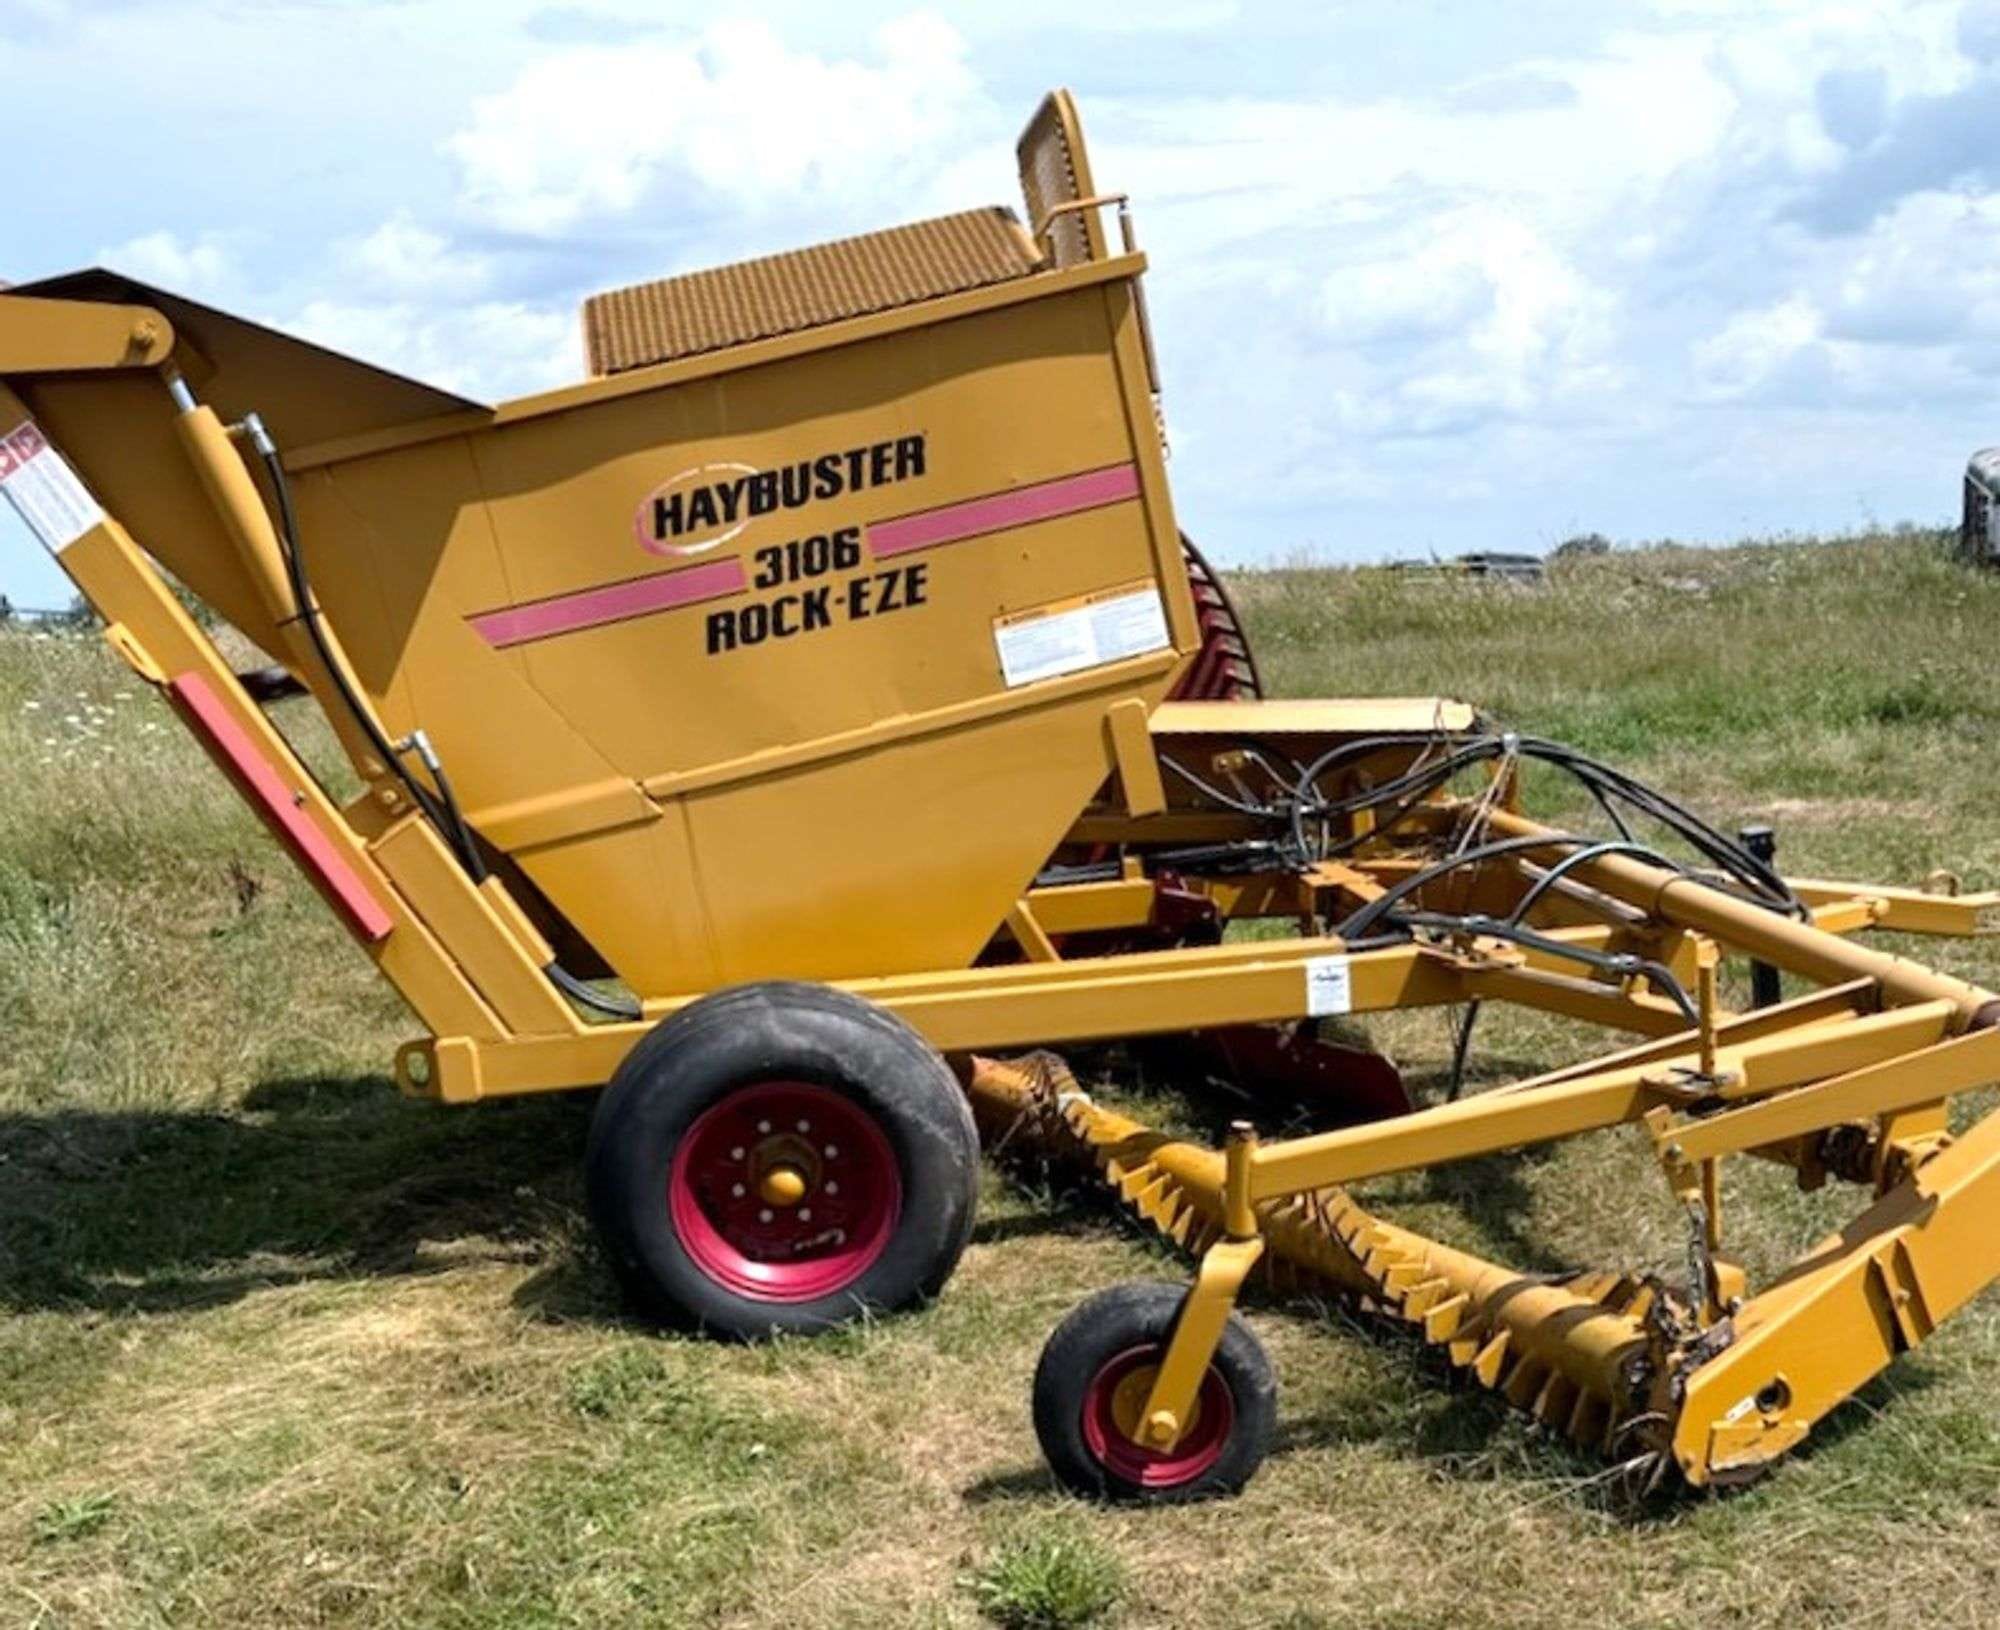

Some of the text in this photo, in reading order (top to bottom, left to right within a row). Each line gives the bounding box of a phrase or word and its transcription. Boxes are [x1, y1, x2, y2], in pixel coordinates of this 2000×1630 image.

[654, 434, 925, 540] HAYBUSTER
[753, 526, 862, 591] 3106
[706, 564, 928, 654] ROCK-EZE
